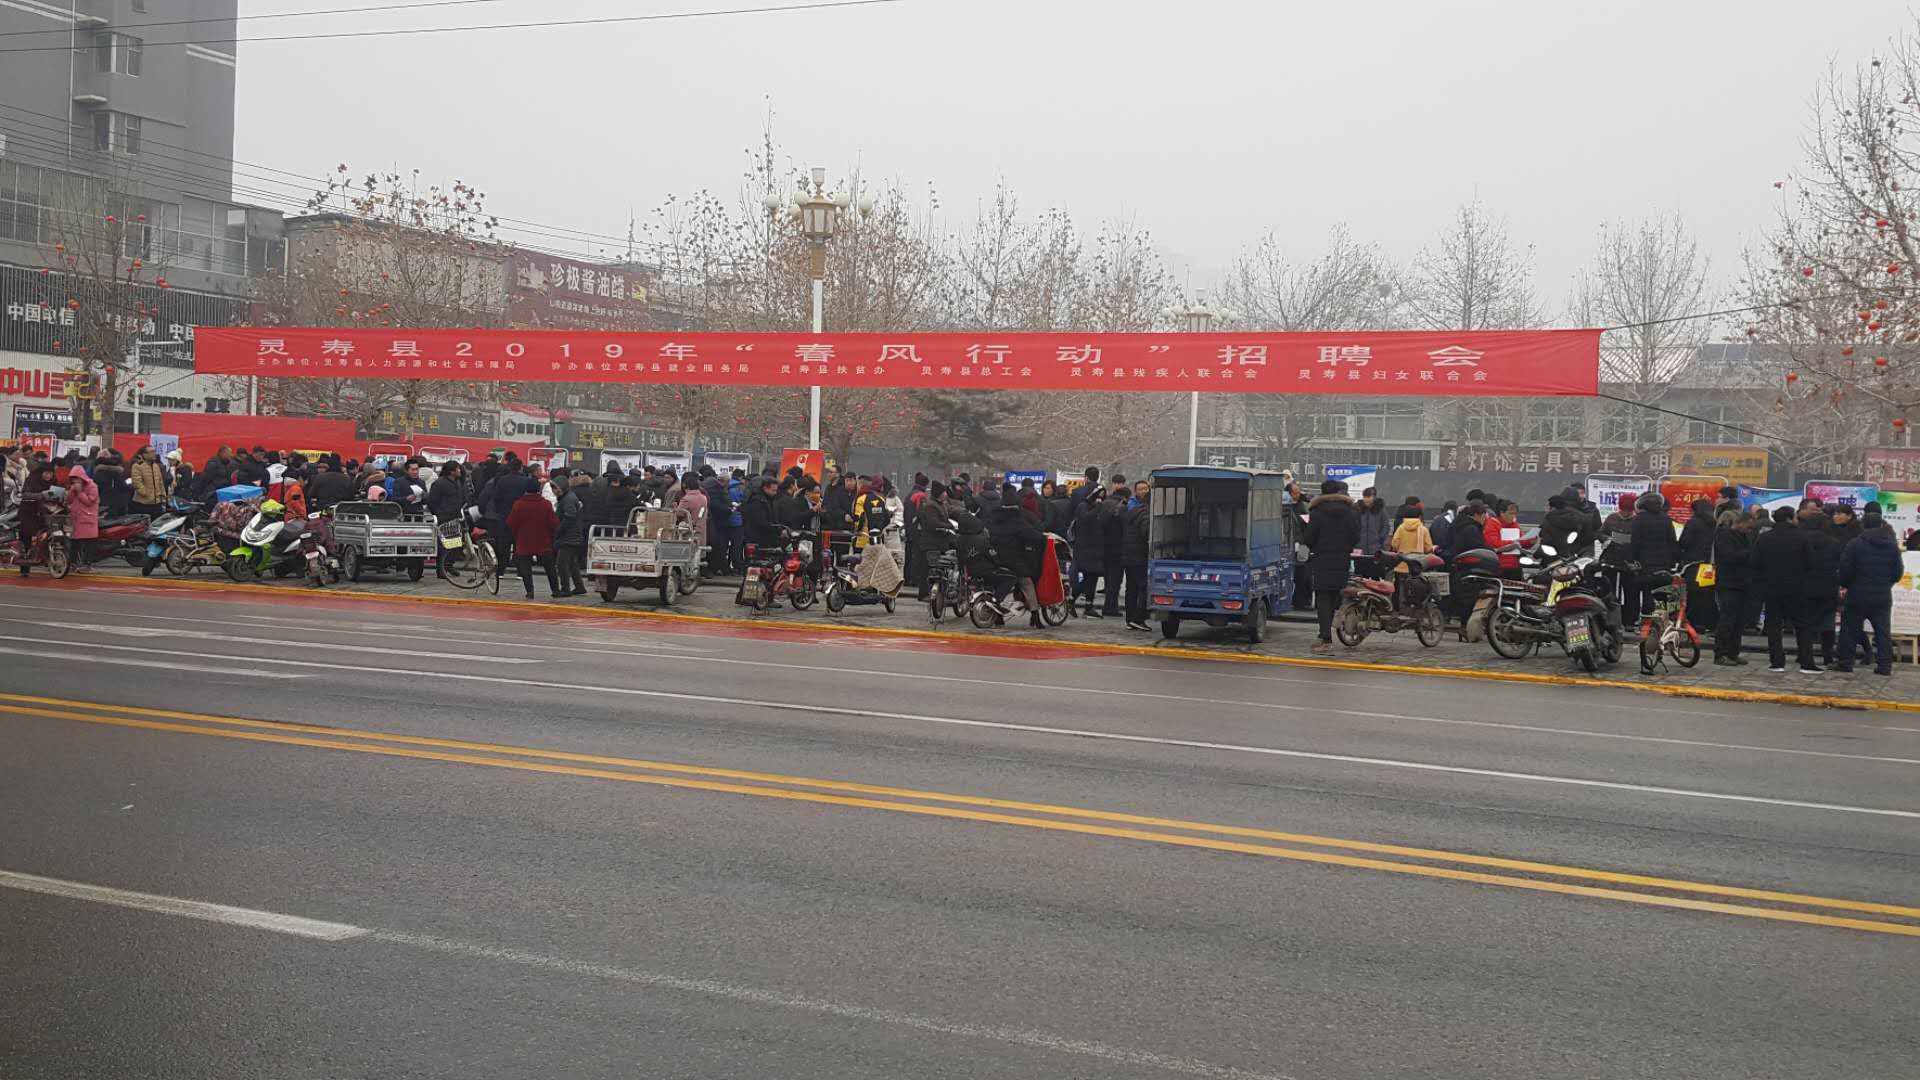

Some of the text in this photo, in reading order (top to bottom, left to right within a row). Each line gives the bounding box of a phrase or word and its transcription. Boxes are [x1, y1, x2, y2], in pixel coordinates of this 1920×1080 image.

[550, 263, 625, 300] 珍极酱油醋
[8, 302, 76, 326] 中国电信
[256, 338, 1485, 367] 灵寿县2019年“春风行动”招聘会
[1298, 369, 1488, 381] 灵寿县妇女联合会
